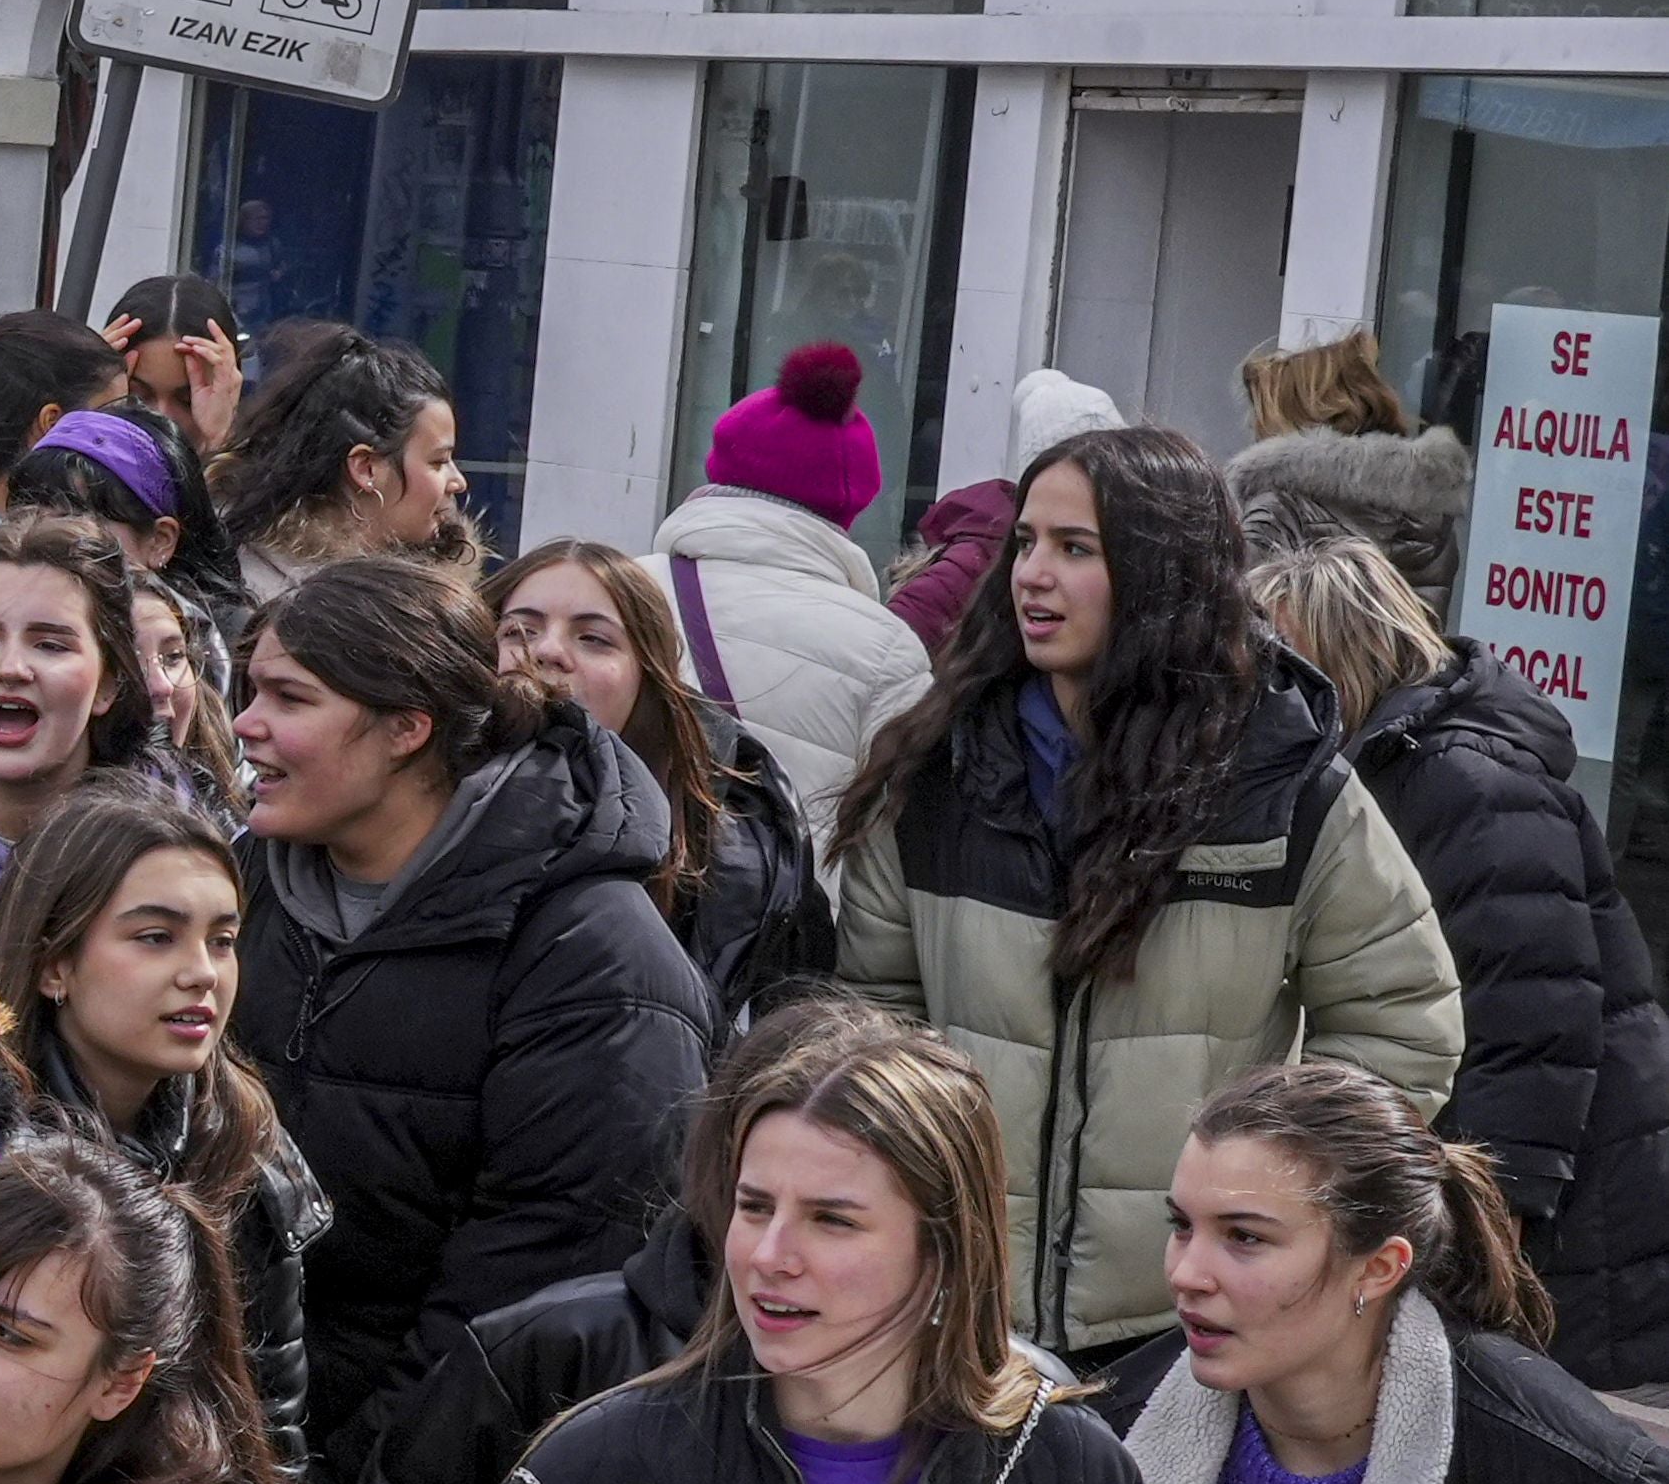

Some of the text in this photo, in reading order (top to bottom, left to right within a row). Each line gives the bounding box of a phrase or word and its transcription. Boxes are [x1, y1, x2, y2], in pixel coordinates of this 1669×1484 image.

[168, 16, 311, 63] IZAN EZIK
[1550, 330, 1592, 377] SE
[1493, 405, 1631, 463] ALQUILA
[1514, 486, 1594, 539] ESTE
[1485, 562, 1606, 622] BONITO
[1489, 642, 1588, 701] OCAL
[1187, 875, 1253, 892] REPUBLIC
